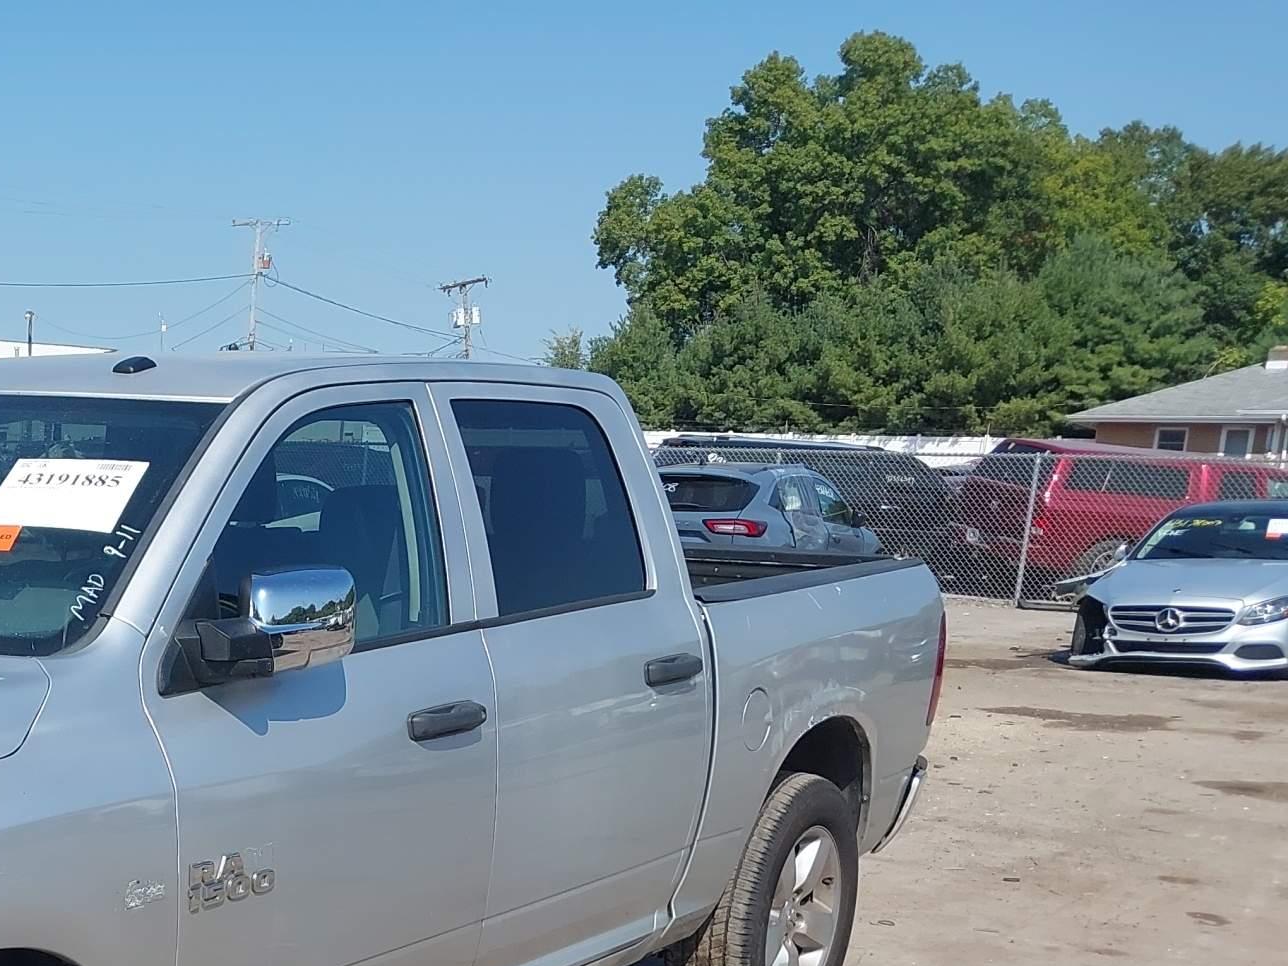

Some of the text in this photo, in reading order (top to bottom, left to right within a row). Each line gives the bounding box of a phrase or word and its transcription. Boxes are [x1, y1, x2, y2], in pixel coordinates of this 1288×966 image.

[17, 472, 124, 488] 43191885
[70, 524, 142, 621] MAD 9-11
[187, 868, 276, 915] 1500
